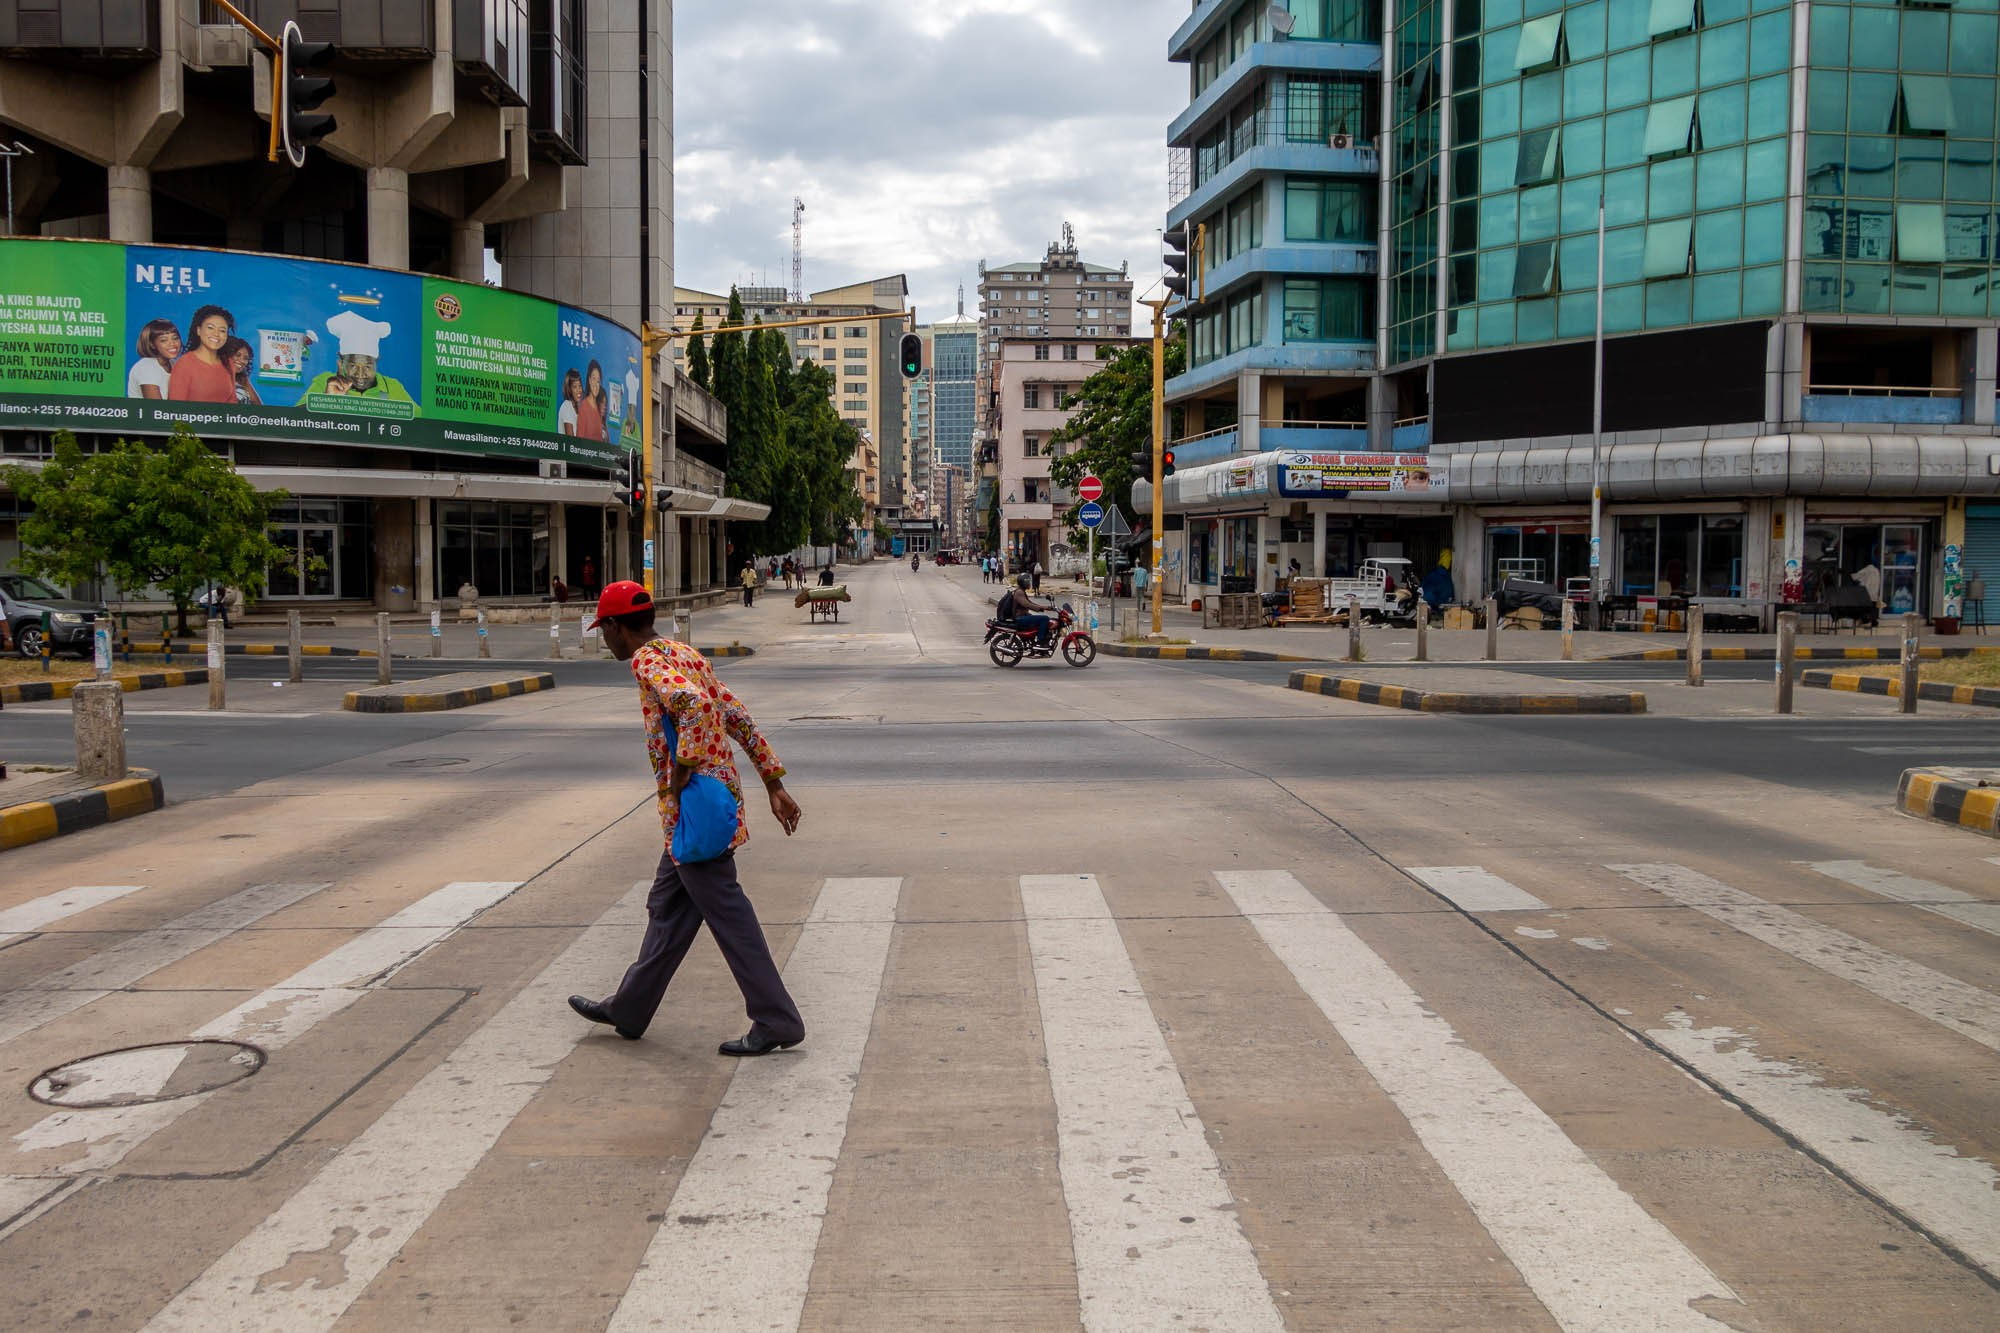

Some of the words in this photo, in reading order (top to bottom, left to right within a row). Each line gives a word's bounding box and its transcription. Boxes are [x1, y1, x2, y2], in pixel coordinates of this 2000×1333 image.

[136, 264, 211, 288] NEEL
[153, 284, 194, 294] SALT
[7, 294, 33, 306] KING
[36, 295, 82, 309] MAJUTO
[15, 309, 59, 321] CHUMVI
[62, 310, 77, 322] YA
[79, 311, 108, 324] NEEL
[38, 324, 63, 336] NJIA
[66, 325, 105, 338] SAHIHI
[562, 320, 596, 345] NEEL
[33, 342, 79, 355] WATOTO
[82, 344, 115, 357] WETU
[435, 330, 469, 344] MAONO
[471, 335, 482, 346] YA
[483, 337, 503, 349] KING
[504, 340, 534, 355] MAJUTO
[30, 356, 111, 370] TUNAHESHIMU
[435, 343, 447, 353] YA
[449, 345, 489, 360] KUTUMIA
[490, 349, 520, 364] CHUMVI
[521, 354, 530, 365] YA
[532, 355, 549, 370] NEEL
[7, 369, 69, 382] MTANZANIA
[72, 372, 104, 383] HUYU
[435, 356, 504, 374] YALITUONYESHA
[505, 364, 522, 377] NJIA
[523, 367, 547, 381] SAHIHI
[435, 372, 447, 383] YA
[449, 374, 501, 391] KUWAFANYA
[502, 381, 532, 395] WATOTO
[533, 385, 552, 398] WETU
[435, 385, 462, 398] KUWA
[464, 388, 498, 403] HODARI,
[499, 392, 550, 409] TUNAHESHIMU
[64, 406, 129, 418] 784402208
[435, 397, 468, 411] MAONO
[471, 401, 482, 412] YA
[483, 403, 526, 418] MTANZANIA
[527, 409, 547, 420] HUYU
[154, 410, 223, 424] Baruapepe:
[226, 413, 360, 432] info@neelkanthsalt.com
[522, 438, 559, 451] 784402208
[1311, 455, 1341, 465] FOCUS
[1344, 455, 1396, 465] OPTOMETRY
[1399, 455, 1428, 465] CLINIC
